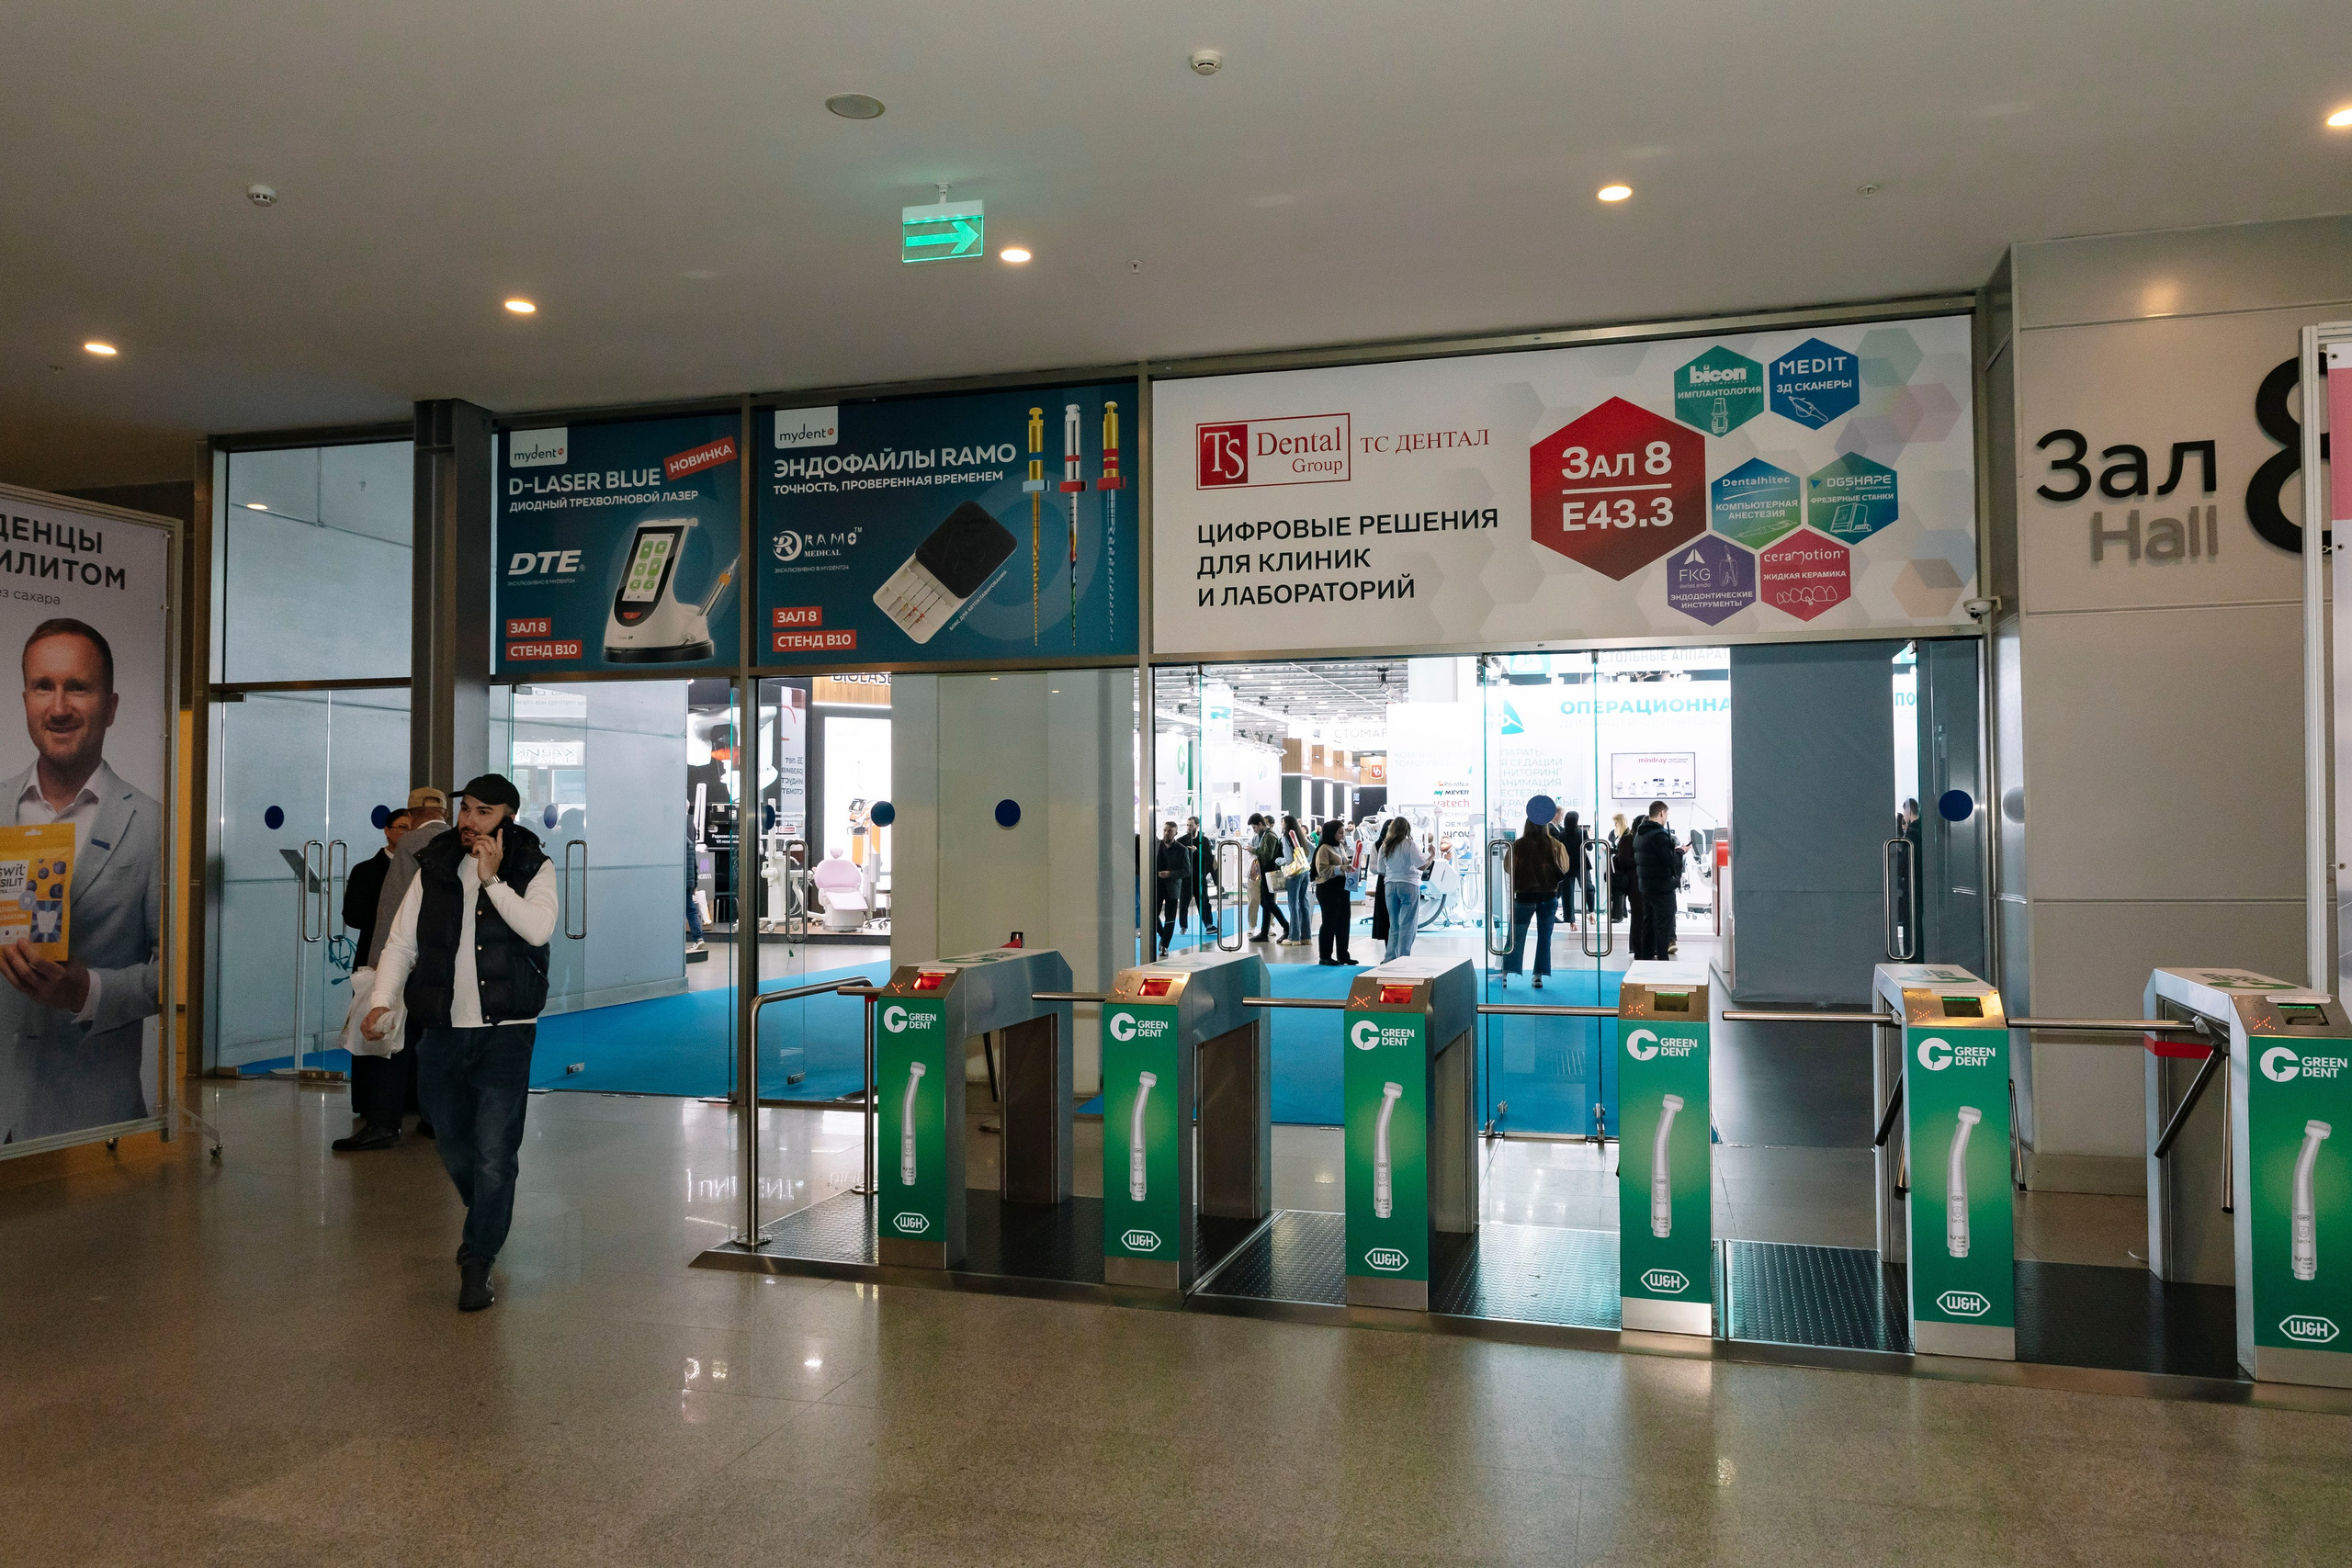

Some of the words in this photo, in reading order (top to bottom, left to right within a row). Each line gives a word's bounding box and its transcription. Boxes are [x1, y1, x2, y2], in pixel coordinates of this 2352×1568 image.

[1779, 356, 1848, 376] MEDIT
[1690, 364, 1747, 384] bicon
[1794, 378, 1852, 391] СКАНЕРЫ
[1678, 386, 1762, 400] ИМПЛАНТОЛОГИЯ
[780, 423, 826, 444] mydent
[1256, 426, 1341, 457] Dental
[1360, 435, 1389, 454] ТС
[1395, 428, 1490, 455] ДЕНТАЛ
[669, 444, 733, 473] НОВИНКА
[774, 447, 935, 479] ЭНДОФАЙЛЫ
[942, 443, 1017, 467] RAMO
[1204, 431, 1245, 479] TS
[1645, 440, 1672, 476] 8
[1292, 457, 1343, 475] Group
[2036, 429, 2217, 502] Зал
[509, 472, 601, 496] D-LASER
[605, 468, 661, 489] BLUE
[774, 481, 839, 495] ТОЧНОСТЬ,
[842, 475, 933, 491] ПРОВЕРЕННАЯ
[935, 470, 1003, 485] ВРЕМЕНЕМ
[1722, 476, 1791, 487] Dentalhitec
[1827, 474, 1892, 488] DGSHAPE
[509, 497, 568, 513] ДИОДНЫЙ
[570, 491, 660, 508] ТРЕХВОЛНОВОЙ
[662, 491, 698, 502] ЛАЗЕР
[1810, 494, 1860, 504] ФРЕЗЕРНЫЕ
[1861, 492, 1894, 502] СТАНКИ
[1715, 499, 1798, 512] КОМПЬЮТЕРНАЯ
[1728, 509, 1785, 520] АНЕСТЕЗИЯ
[1198, 516, 1351, 547] ЦИФРОВЫЕ
[1360, 508, 1498, 536] РЕШЕНИЯ
[2091, 504, 2219, 562] Hall
[804, 549, 842, 558] MEDICAL
[1197, 554, 1250, 580] ДЛЯ
[1260, 547, 1371, 572] КЛИНИК
[1679, 568, 1711, 582] FKG
[1763, 572, 1800, 581] ЖИДКАЯ
[1802, 570, 1847, 579] КЕРАМИКА
[1198, 588, 1214, 607] И
[1220, 573, 1415, 606] ЛАБОРАТОРИЙ
[1670, 591, 1753, 602] ЭНДОДОНТИЧЕСКИЕ
[14, 590, 61, 605] сахара
[1681, 600, 1743, 609] ИНСТРУМЕНТЫ
[777, 611, 805, 623] ЗАЛ
[808, 611, 818, 622] 8
[510, 622, 536, 633] ЗАЛ
[538, 622, 547, 633] 8
[777, 635, 824, 649] СТЕНД
[510, 645, 553, 657] СТЕНД
[1585, 651, 1667, 663] НСТОЛЬНЫЕ
[832, 674, 891, 684] BIOLAS
[1510, 758, 1563, 767] СЕДАЦИИ
[909, 1012, 936, 1022] GREEN
[909, 1021, 932, 1030] DENT
[1137, 1020, 1169, 1030] GREEN
[1137, 1028, 1162, 1038] DENT
[1381, 1028, 1415, 1038] GREEN
[1382, 1036, 1408, 1047] DENT
[1660, 1037, 1698, 1048] GREEN
[1660, 1047, 1690, 1058] DENT
[1954, 1045, 1996, 1058] GREEN
[1955, 1055, 1988, 1067] DENT
[2301, 1056, 2348, 1069] GREEN
[2301, 1066, 2339, 1079] DENT
[899, 1217, 922, 1230] W&H
[1128, 1234, 1153, 1247] W&H
[1374, 1252, 1400, 1267] W&H
[1650, 1273, 1680, 1290] W&H
[1946, 1295, 1980, 1312] W&H
[2290, 1320, 2328, 1338] W&H
